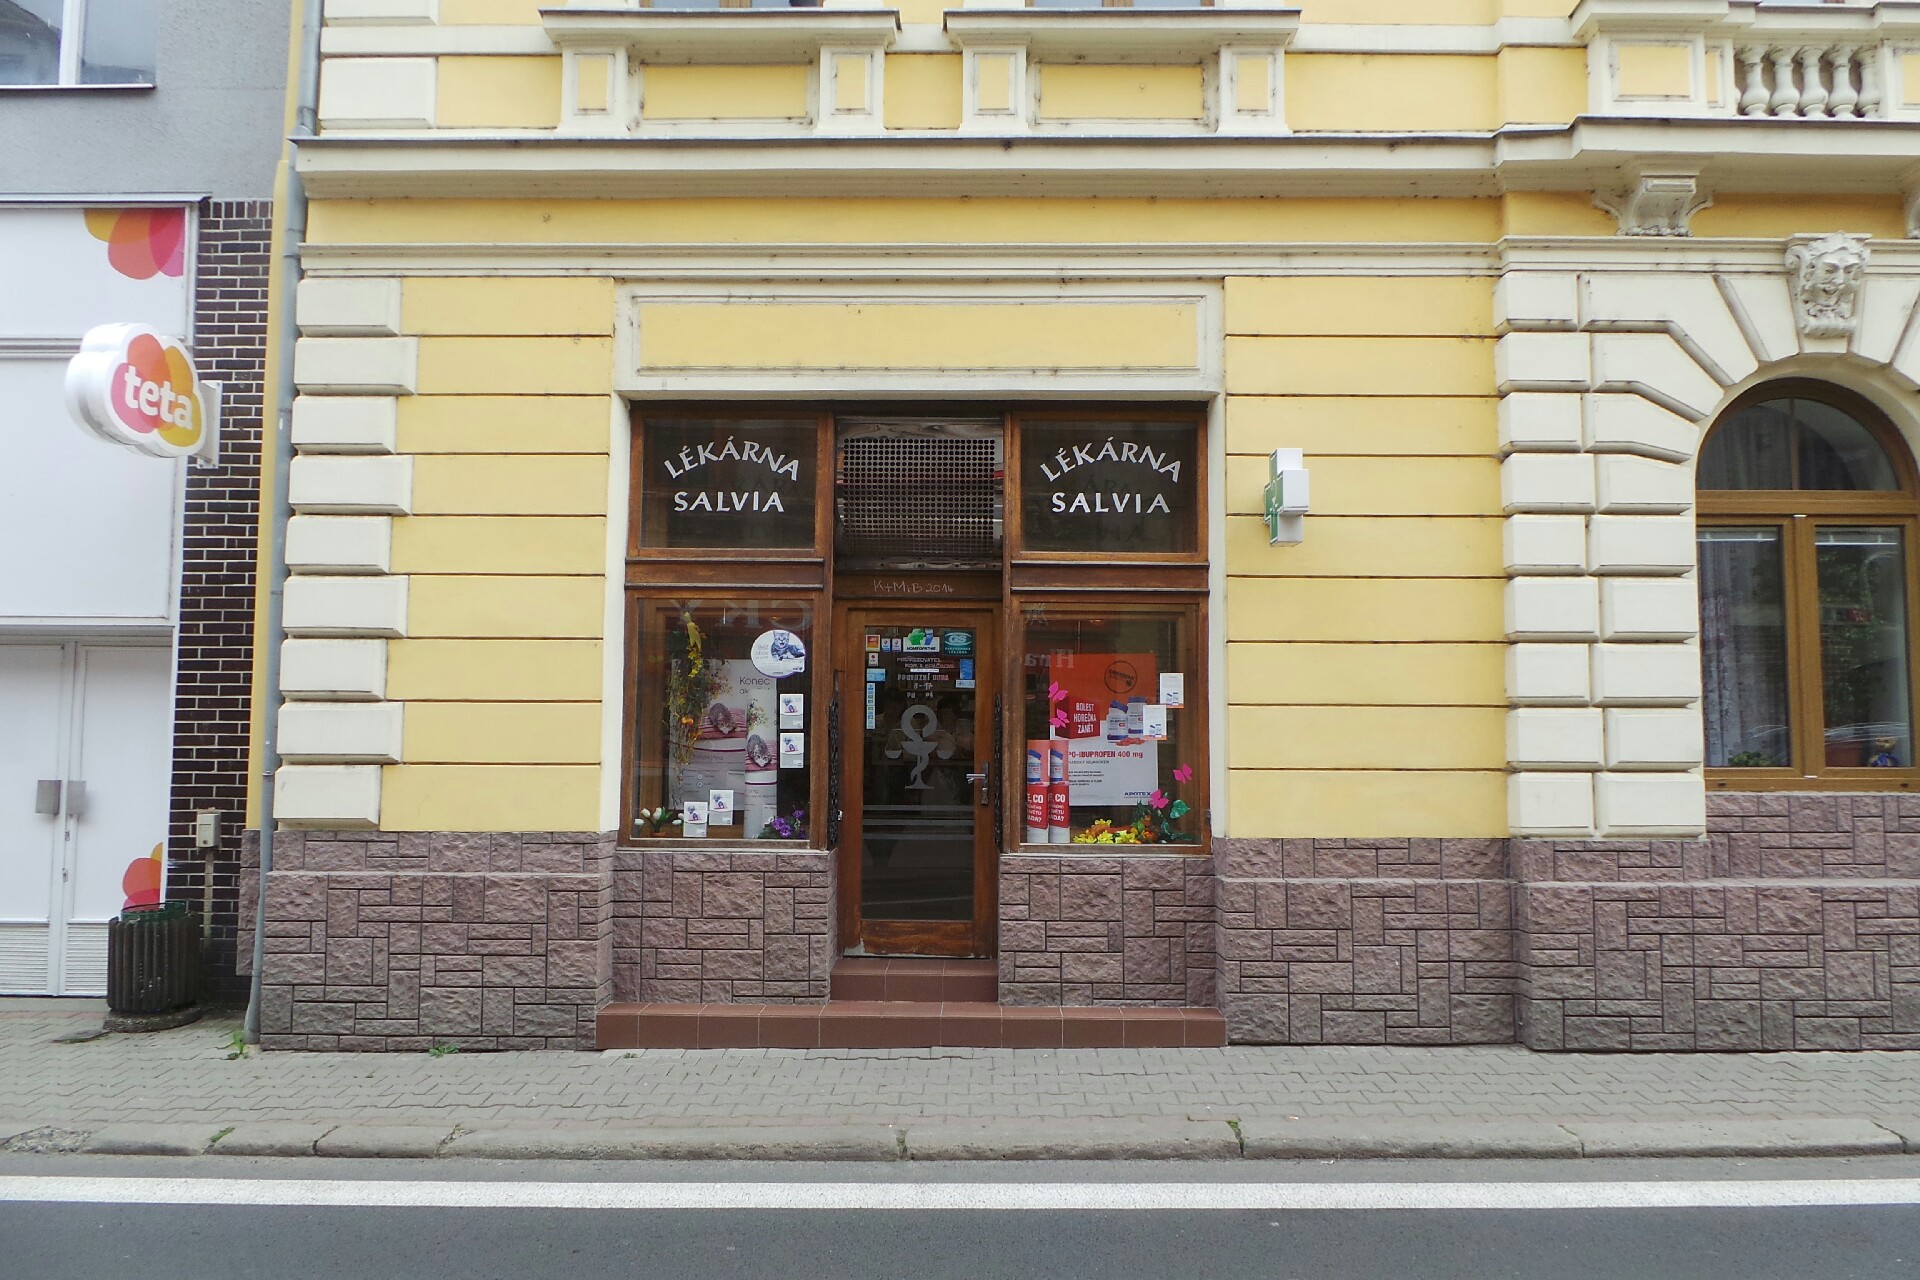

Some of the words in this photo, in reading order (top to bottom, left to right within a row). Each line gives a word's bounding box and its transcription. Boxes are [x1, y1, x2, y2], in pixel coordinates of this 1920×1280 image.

[124, 365, 193, 431] teta
[663, 435, 800, 482] LÉKÁRNA
[1040, 436, 1181, 483] LÉKÁRNA
[674, 491, 785, 513] SALVIA
[1051, 492, 1171, 514] SALVIA
[925, 582, 955, 594] 2014
[739, 676, 770, 686] Konec
[1075, 702, 1095, 712] BOLEST
[1073, 712, 1097, 723] HOREČKA
[1068, 750, 1116, 758] PO-IBUPROFEN
[1117, 750, 1131, 758] 400
[1132, 751, 1144, 759] mg
[1032, 794, 1044, 804] CO
[1055, 793, 1066, 803] CO
